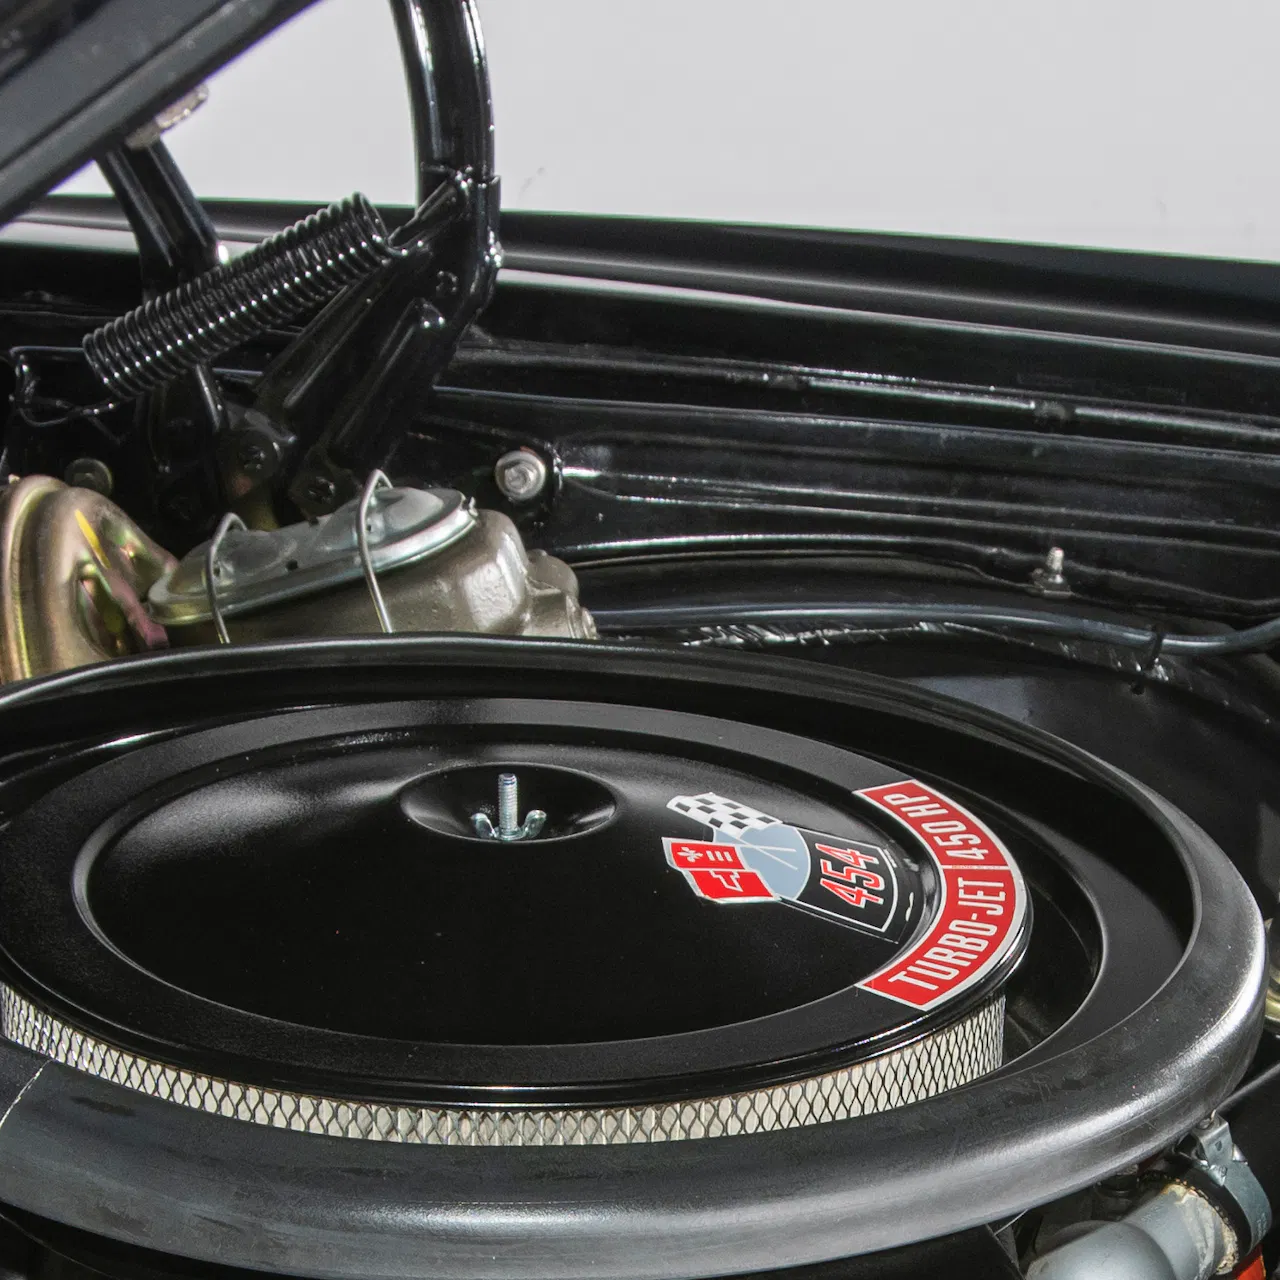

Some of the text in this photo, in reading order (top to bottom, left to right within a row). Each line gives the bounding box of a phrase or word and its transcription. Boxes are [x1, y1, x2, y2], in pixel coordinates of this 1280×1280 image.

[883, 793, 938, 819] HP
[934, 819, 989, 860] 450
[815, 842, 885, 908] 454
[888, 877, 1006, 990] TURBO-JET
